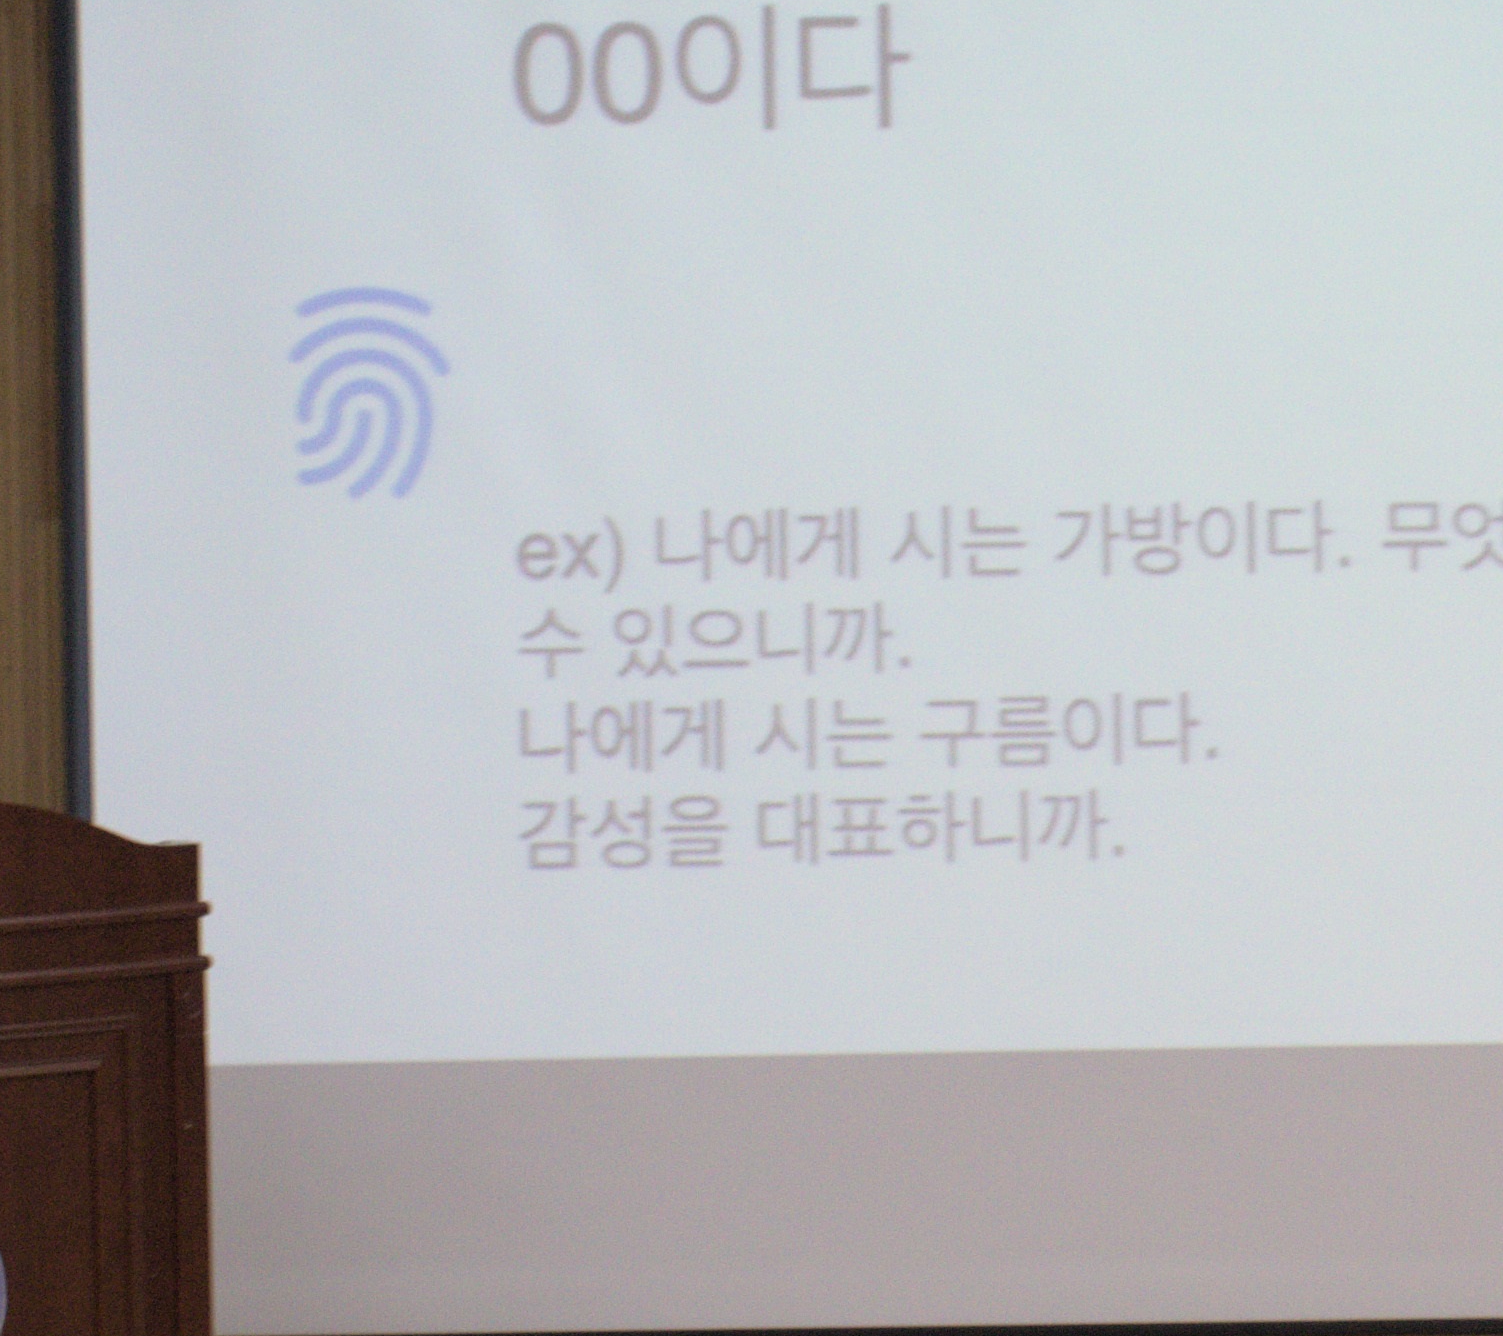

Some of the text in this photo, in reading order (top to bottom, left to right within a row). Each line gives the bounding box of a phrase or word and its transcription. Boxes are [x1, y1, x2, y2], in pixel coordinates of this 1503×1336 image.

[516, 518, 624, 592] ex)
[655, 507, 859, 581] 나에게
[891, 506, 1026, 578] 시는
[1056, 500, 1350, 576] 가방이다.
[519, 602, 910, 678] 수 있으니까.
[519, 692, 1218, 773] 나에게 시는 구름이다.
[519, 789, 1124, 870] 감성을 대표하니까.
